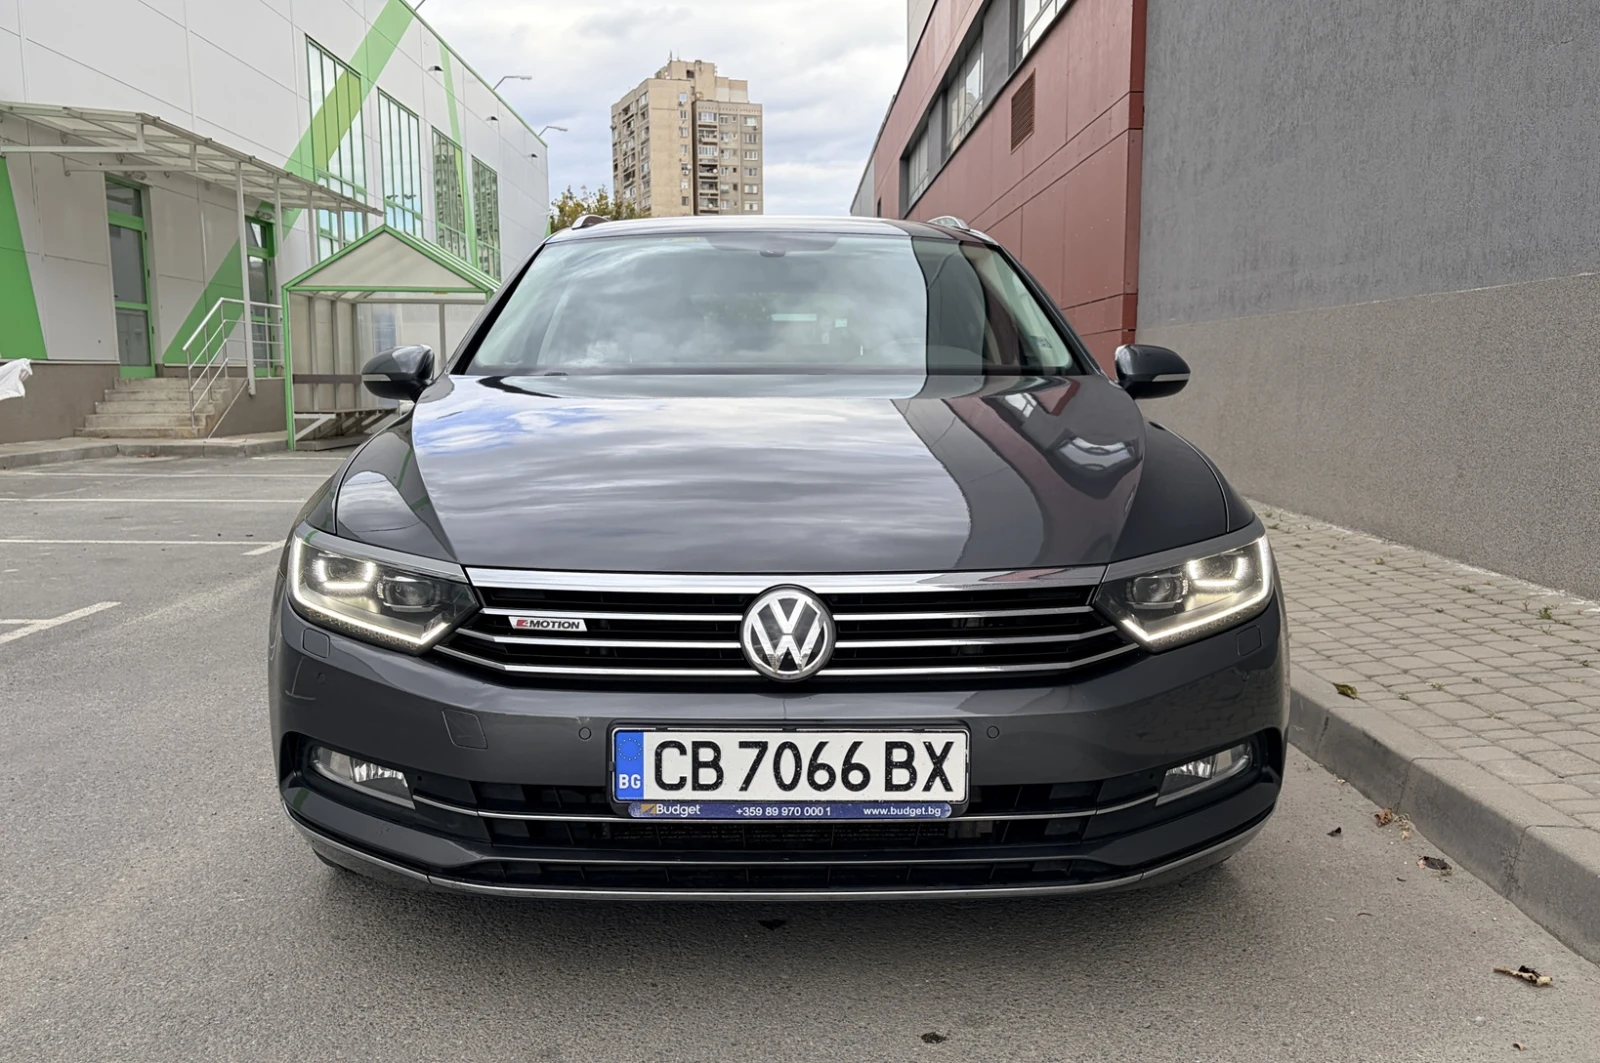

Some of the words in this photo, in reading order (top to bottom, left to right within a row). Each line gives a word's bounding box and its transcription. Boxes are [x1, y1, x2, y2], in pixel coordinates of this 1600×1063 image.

[748, 594, 827, 674] VW
[654, 740, 724, 792] CB
[738, 740, 871, 792] 7066
[884, 740, 955, 792] BX
[618, 774, 642, 789] BG
[656, 803, 701, 817] Budget
[736, 806, 763, 816] +359
[765, 806, 779, 816] 89
[781, 806, 801, 816] 970
[863, 805, 941, 817] www.budget.bg
